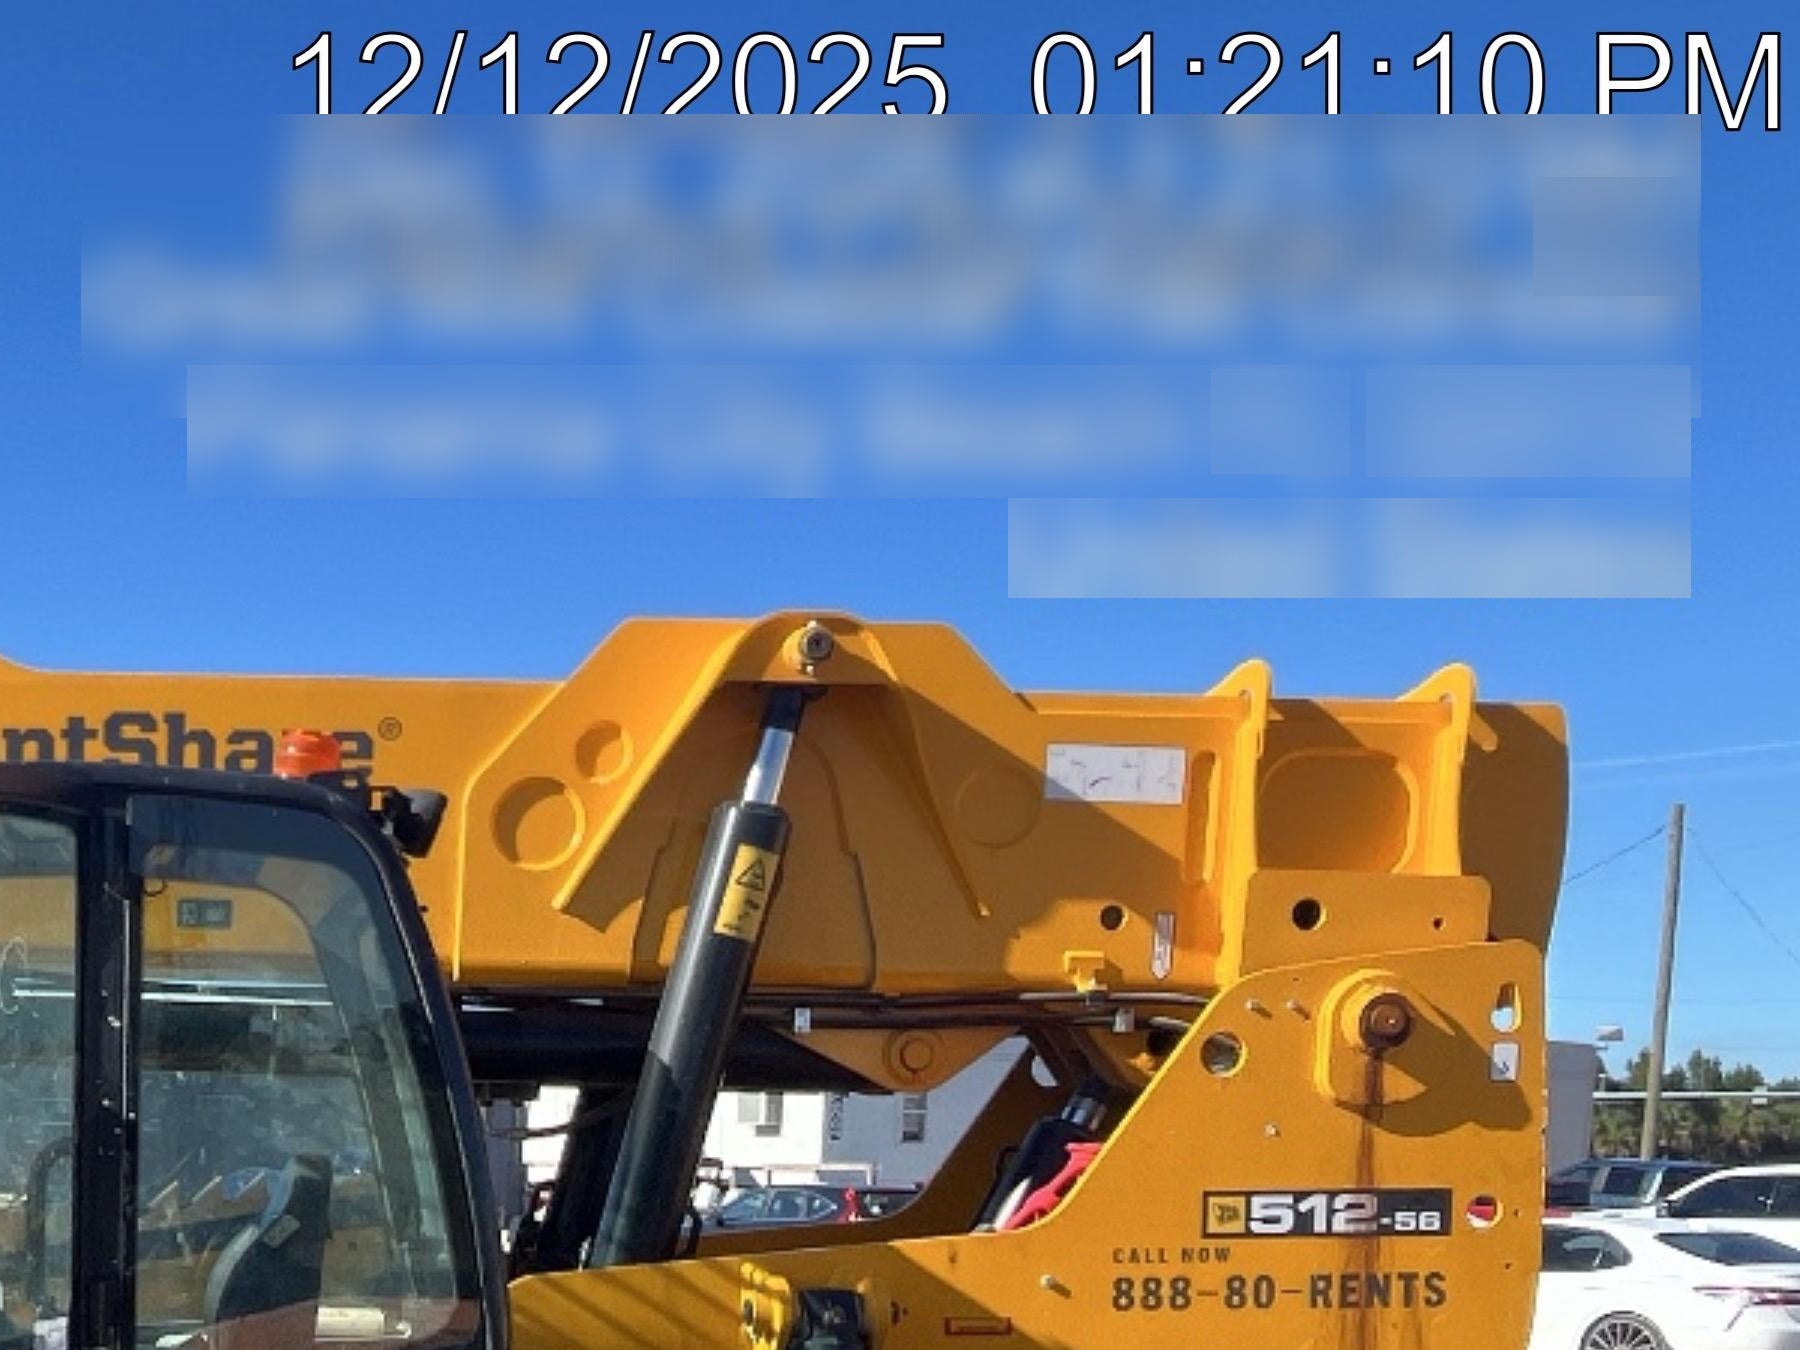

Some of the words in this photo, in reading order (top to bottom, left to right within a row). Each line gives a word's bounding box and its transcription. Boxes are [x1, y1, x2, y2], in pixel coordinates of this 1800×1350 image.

[1247, 1193, 1443, 1236] 512-56
[1112, 1247, 1169, 1264] CALL
[1181, 1246, 1232, 1263] NOW
[1111, 1271, 1448, 1312] 888-80-RENTS
